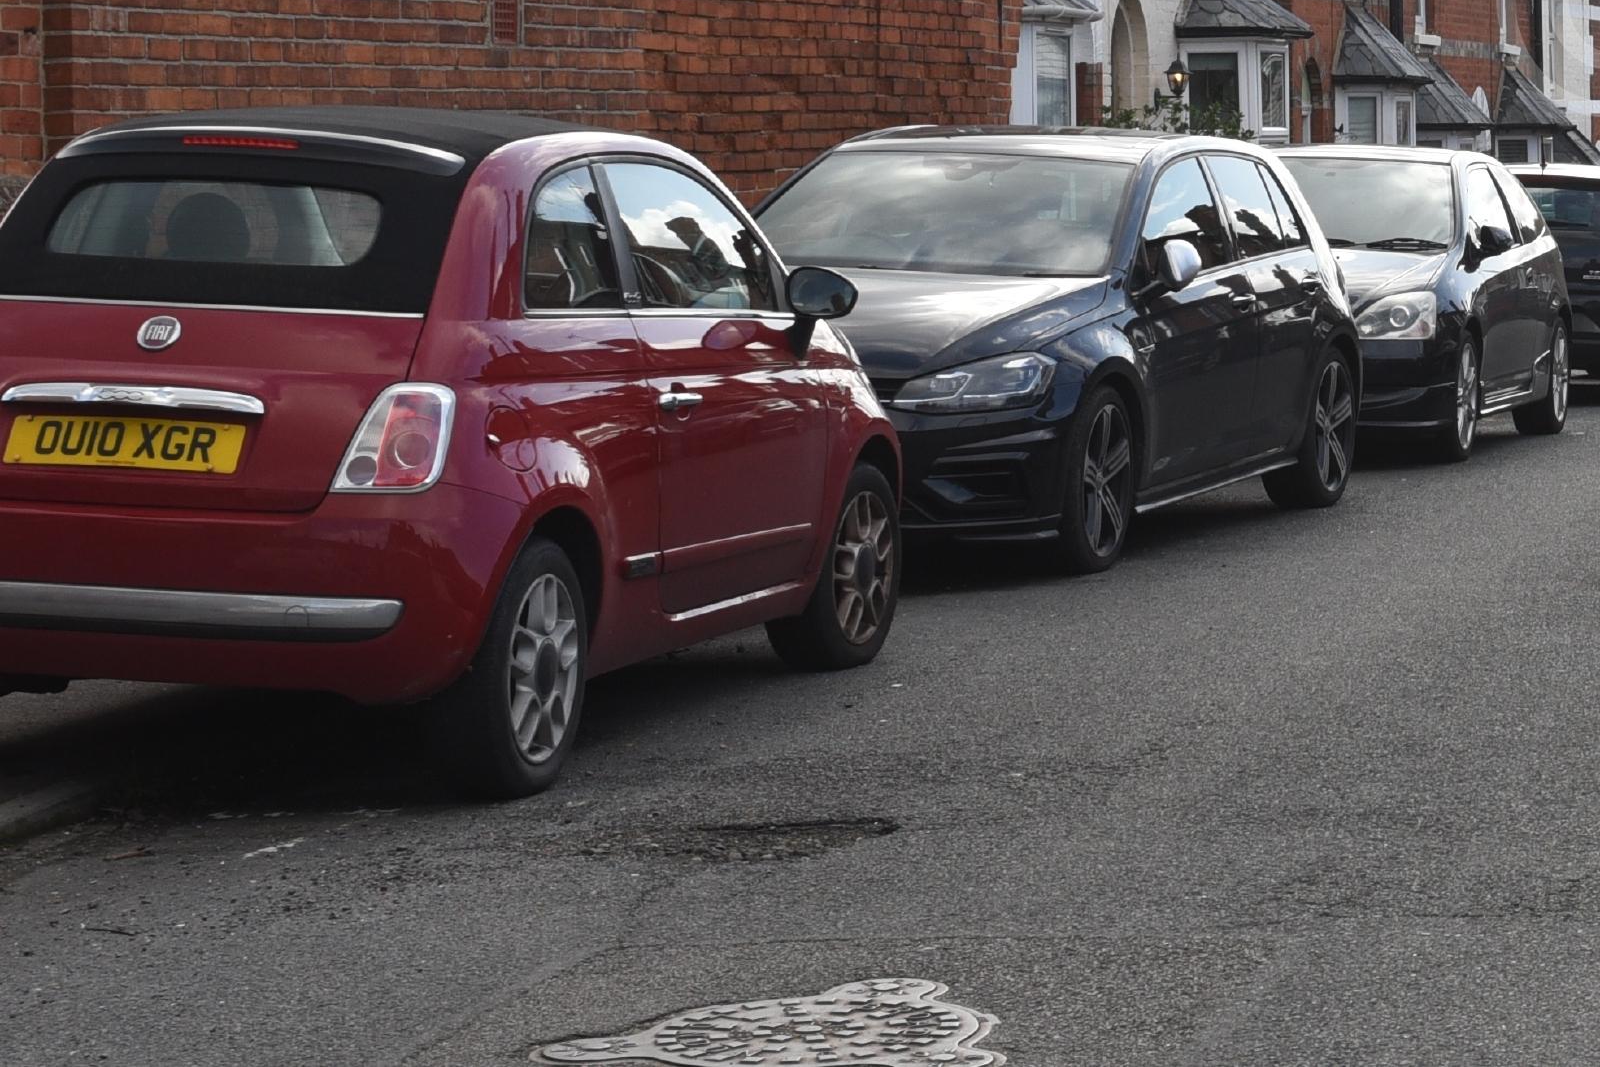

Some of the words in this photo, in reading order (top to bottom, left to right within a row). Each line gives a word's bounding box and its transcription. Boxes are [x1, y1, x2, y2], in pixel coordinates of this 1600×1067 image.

[146, 325, 173, 341] FIAT
[98, 388, 145, 401] 500
[34, 420, 126, 457] OU10
[132, 423, 217, 463] XGR
